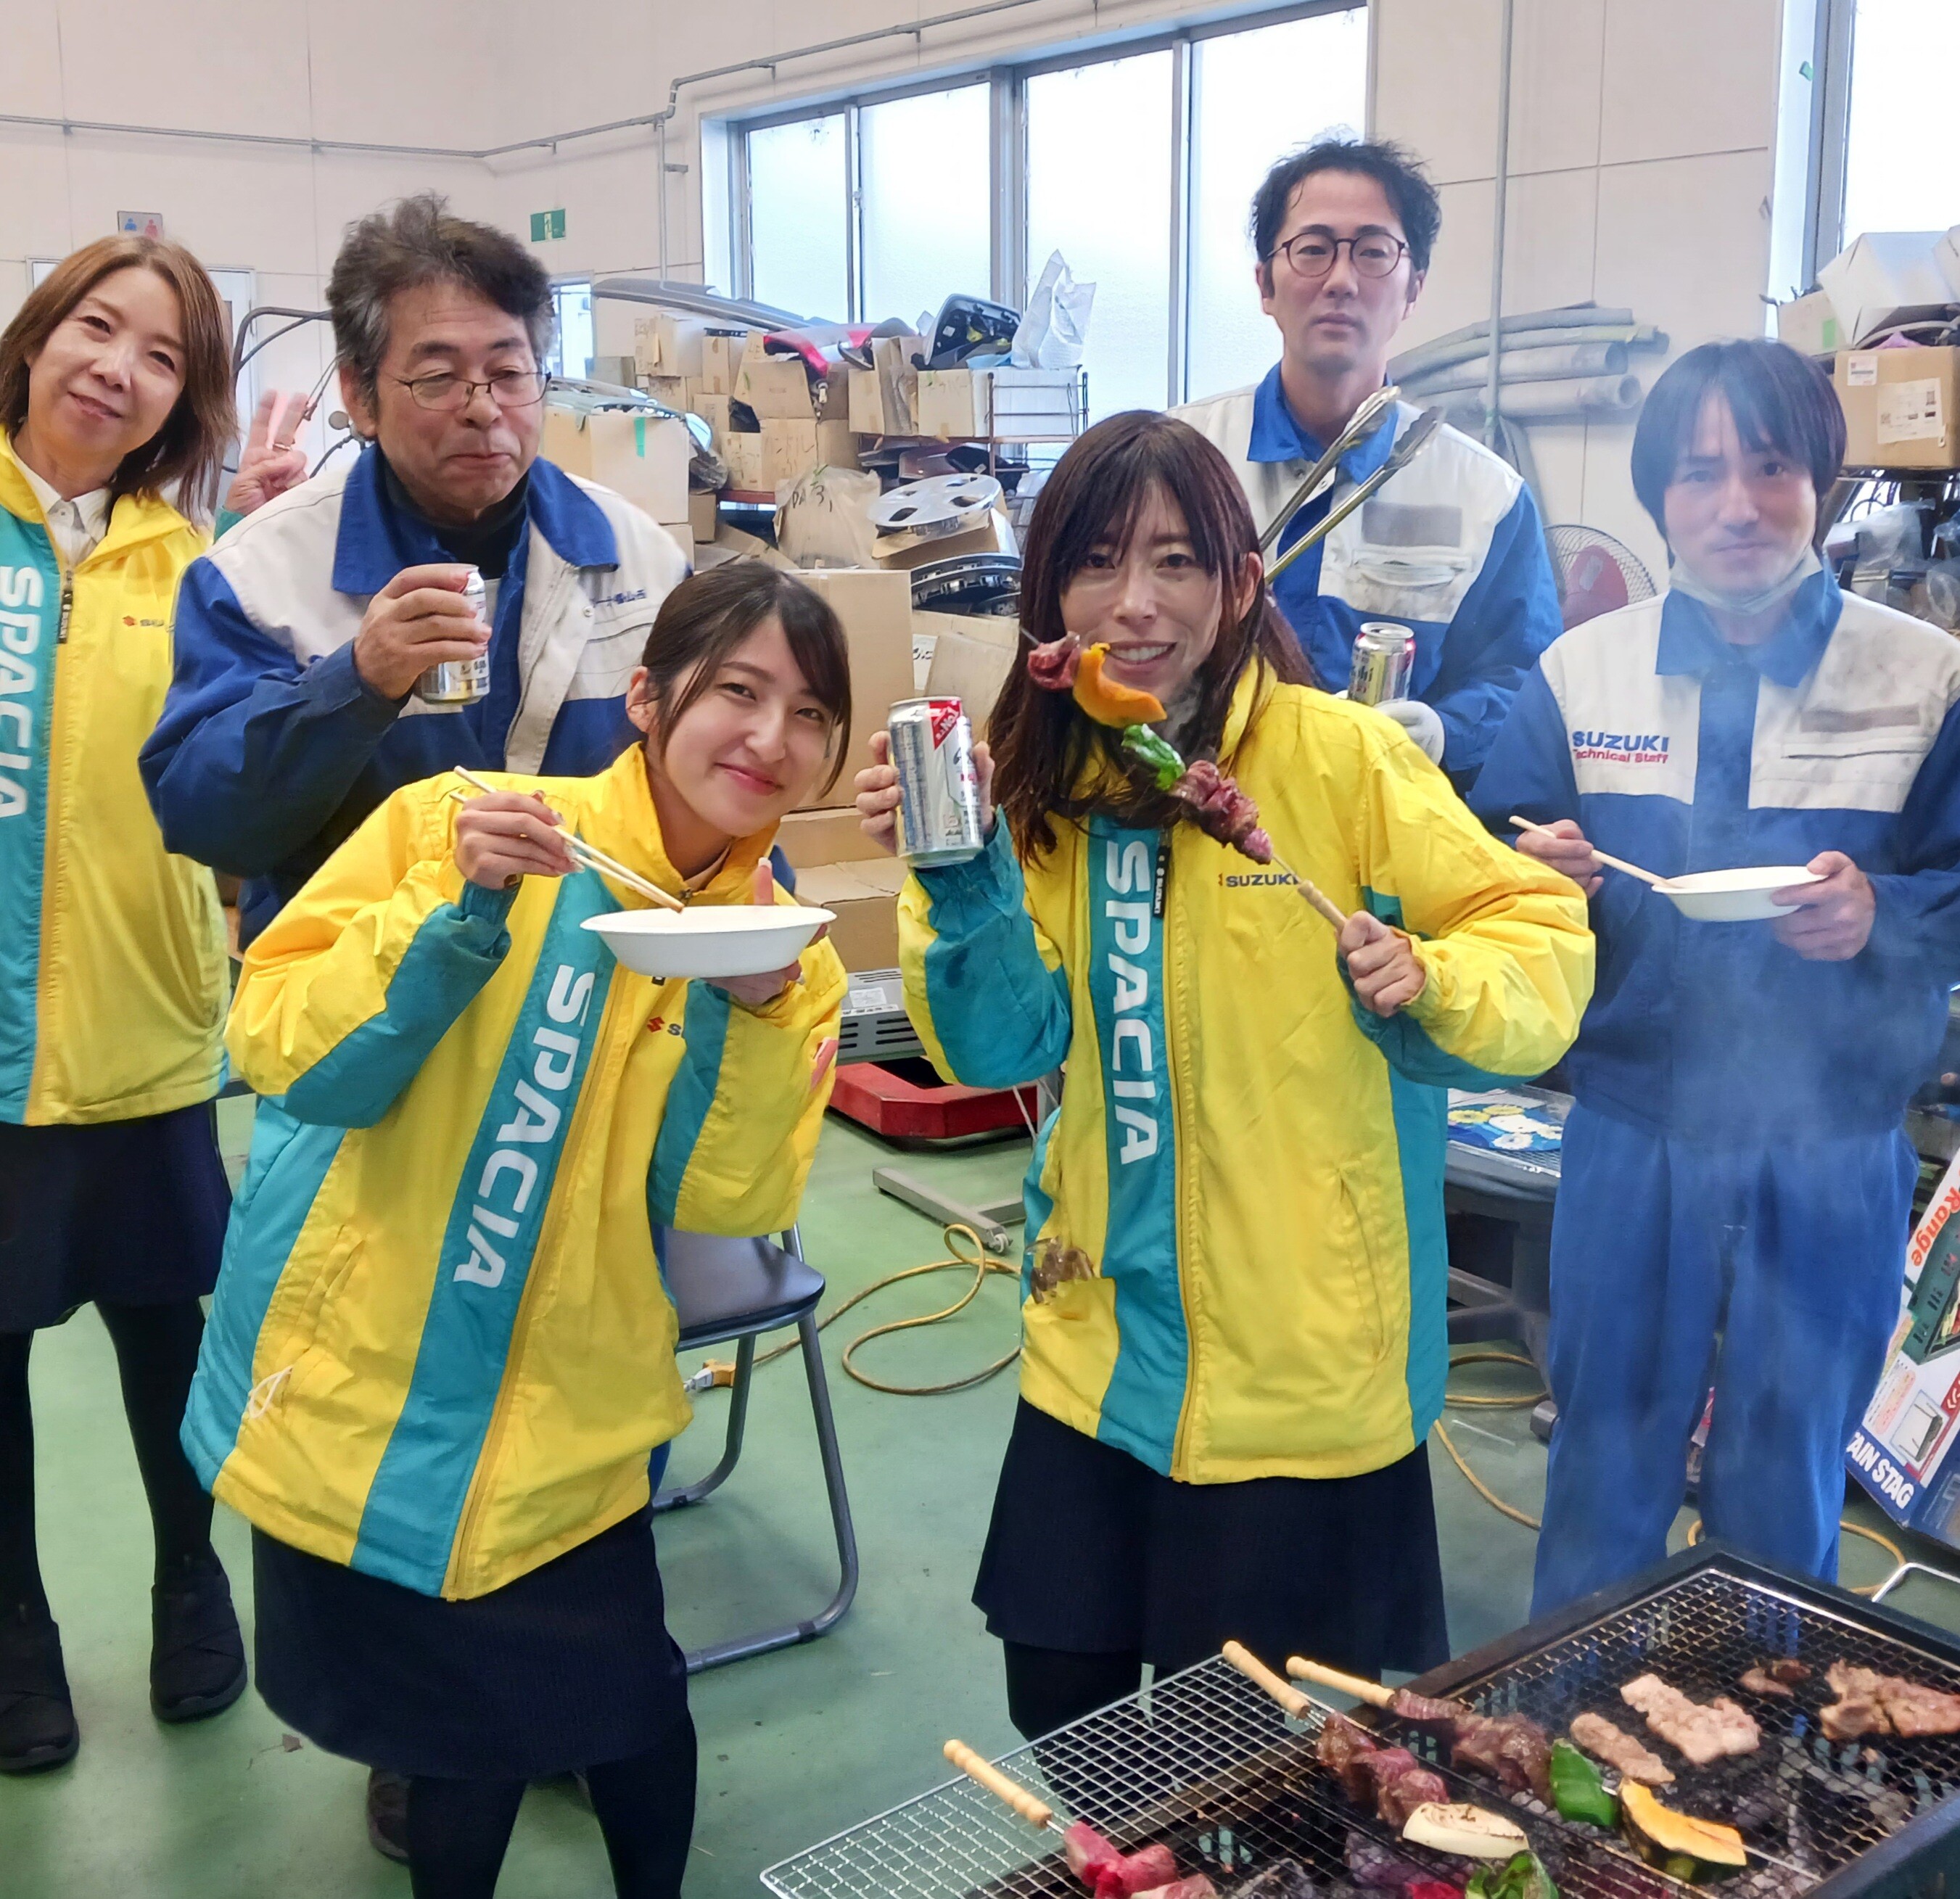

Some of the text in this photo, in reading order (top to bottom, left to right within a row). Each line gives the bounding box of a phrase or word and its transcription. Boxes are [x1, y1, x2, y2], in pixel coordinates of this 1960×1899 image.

[0, 566, 44, 818] SPACIA
[1573, 730, 1669, 752] SUZUKI
[1635, 753, 1669, 764] Staff
[1226, 873, 1298, 887] SUZUKI
[1105, 840, 1158, 1166] SPACIA
[453, 964, 596, 1289] SPACIA
[1910, 1185, 1960, 1267] Range
[1846, 1430, 1881, 1472] AIN
[1872, 1458, 1914, 1509] STAG
